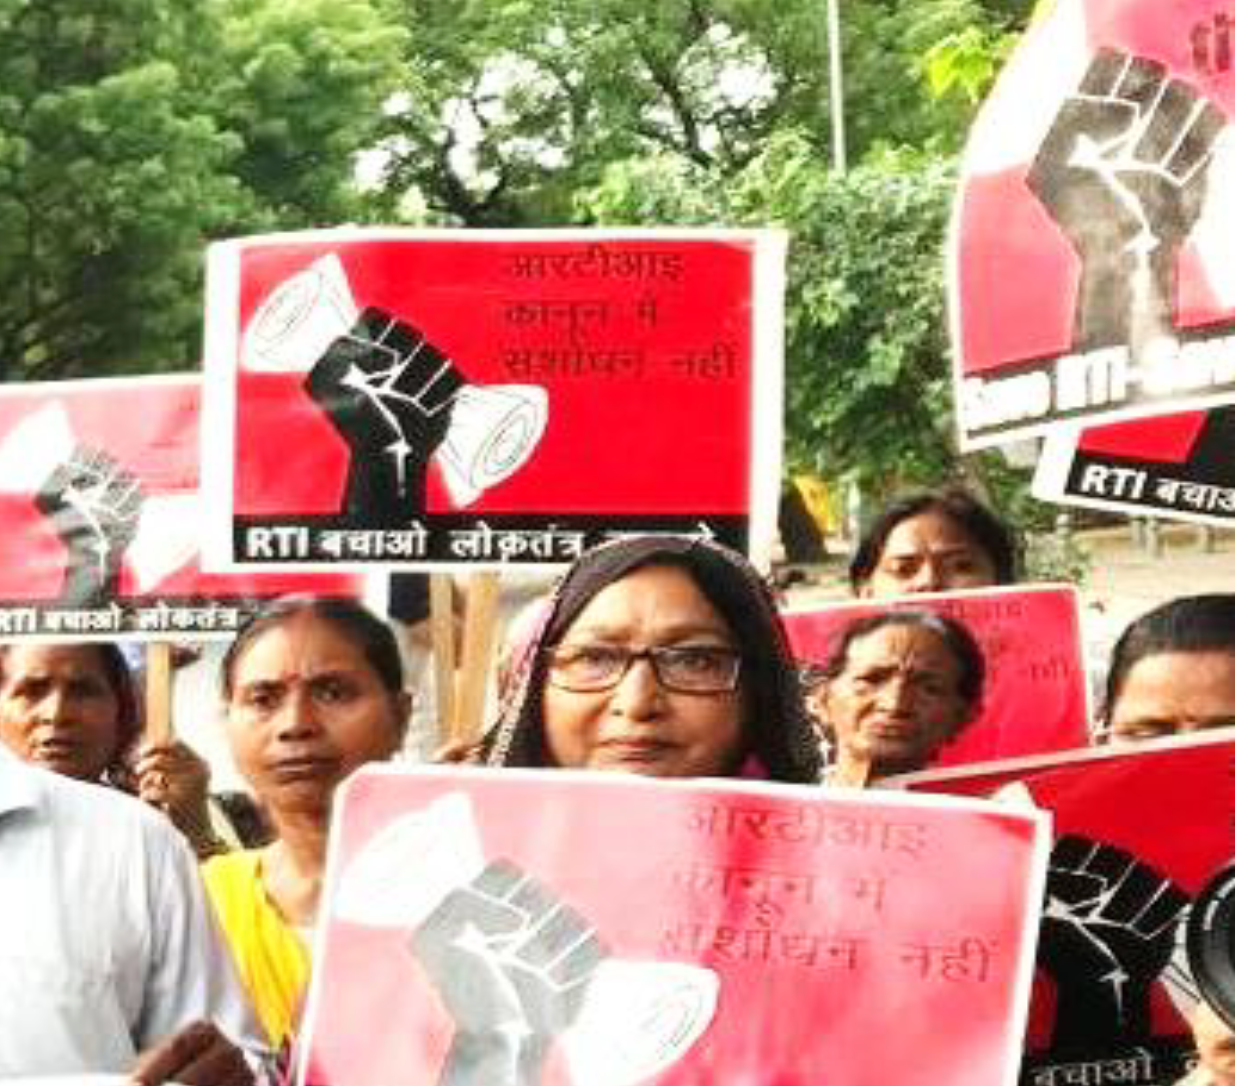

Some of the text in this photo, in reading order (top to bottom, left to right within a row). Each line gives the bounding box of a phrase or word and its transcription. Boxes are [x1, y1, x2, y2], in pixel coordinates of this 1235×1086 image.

[1081, 464, 1148, 499] RTI
[247, 527, 309, 558] RTI
[319, 520, 428, 558] बचाओ
[448, 520, 584, 563] लोकतंत्र
[897, 934, 1000, 983] नहीं
